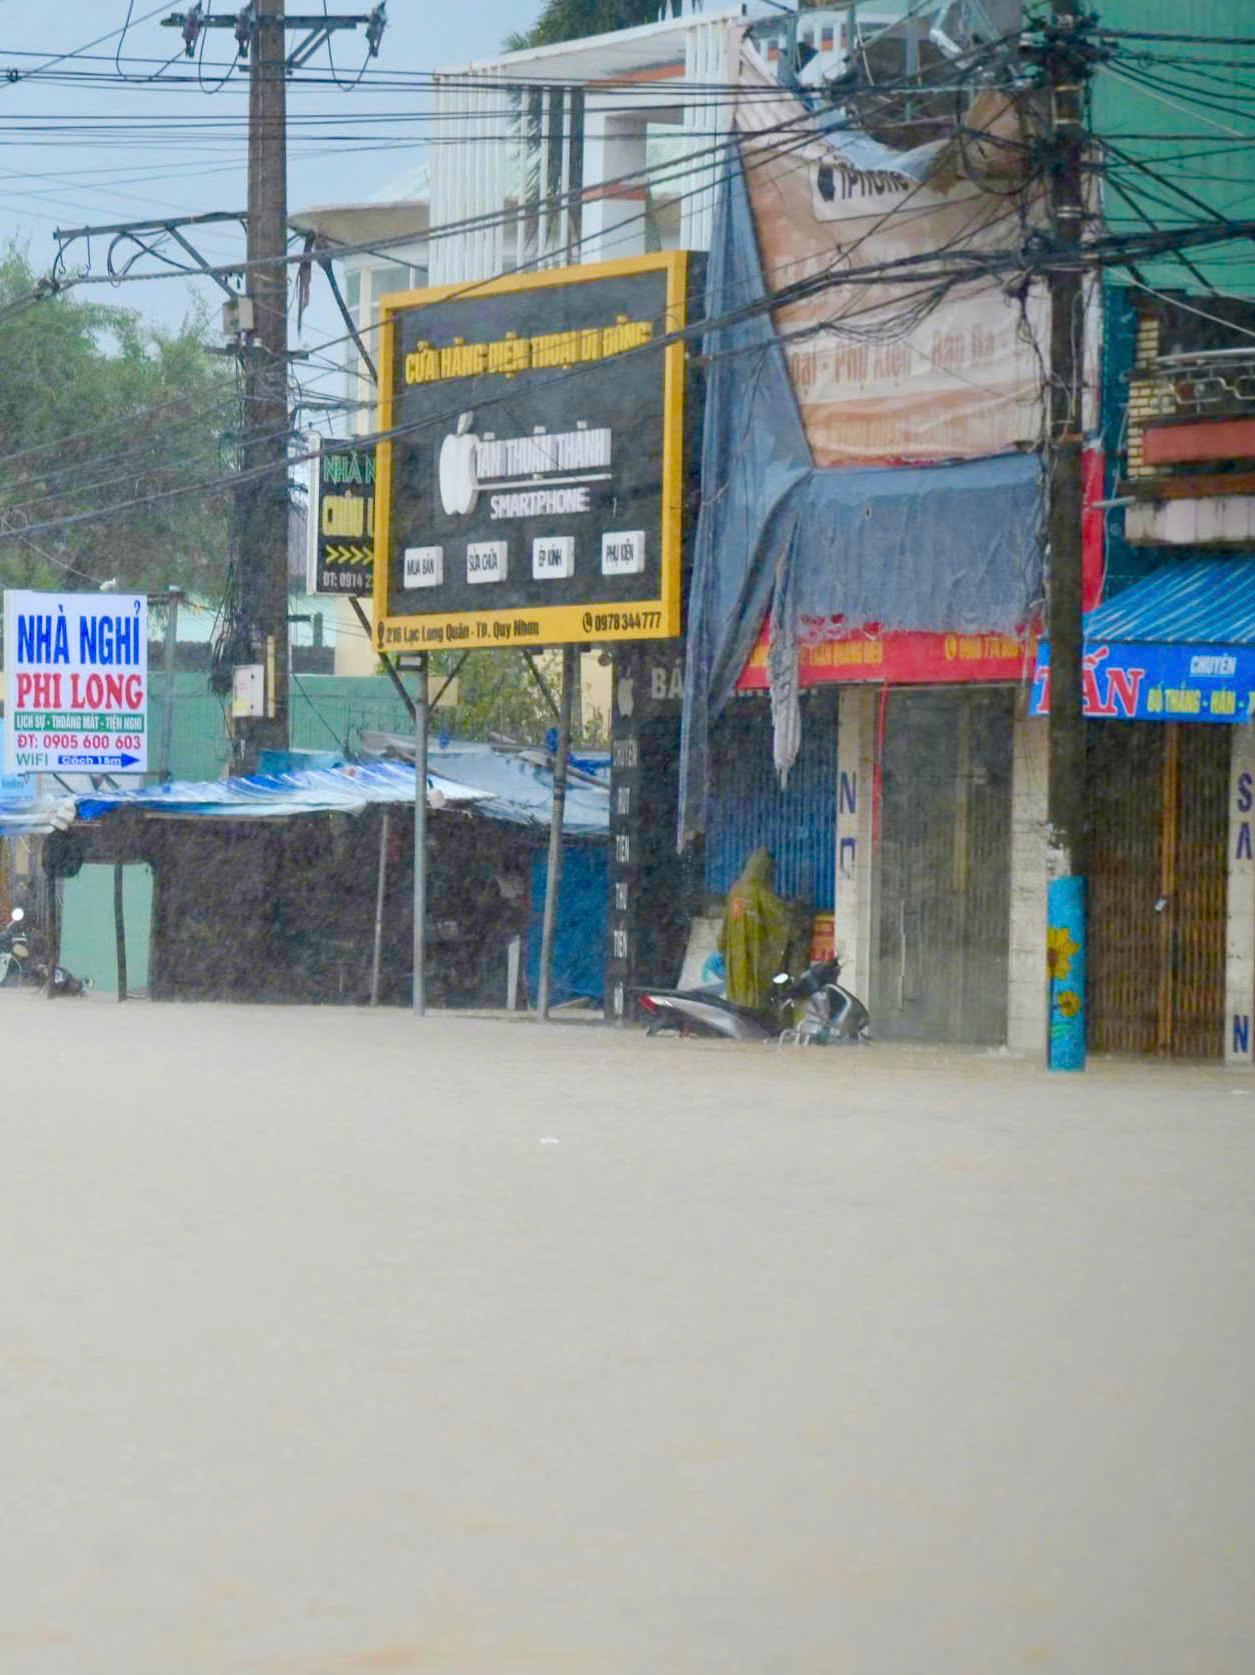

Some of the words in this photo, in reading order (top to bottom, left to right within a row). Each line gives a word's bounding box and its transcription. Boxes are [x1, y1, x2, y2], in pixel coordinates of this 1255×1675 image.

[441, 336, 488, 379] HÀNG
[531, 330, 581, 370] THOẠI
[490, 486, 591, 520] SMARTPHONE
[407, 560, 421, 576] MUA
[422, 553, 435, 575] BÁN
[469, 549, 481, 573] SỬA
[482, 547, 498, 570] CHỮA
[606, 544, 619, 566] PHỤ
[620, 538, 635, 565] KIỆN
[17, 604, 71, 665] NHÀ
[79, 600, 142, 666] NGHỈ
[403, 626, 420, 646] Lạc
[421, 624, 444, 643] Long
[445, 622, 470, 642] Quân
[493, 621, 512, 643] Quy
[16, 672, 62, 709] PHI
[70, 672, 144, 710] LONG
[16, 714, 34, 731] LỊCH
[34, 714, 47, 731] SỰ
[52, 714, 82, 732] THOÁNG
[83, 714, 99, 732] MÁT
[17, 734, 38, 749] ĐT:
[43, 734, 79, 749] 0905
[82, 734, 110, 749] 600
[115, 734, 141, 750] 603
[16, 752, 49, 767] WIFI
[61, 754, 94, 766] Cách
